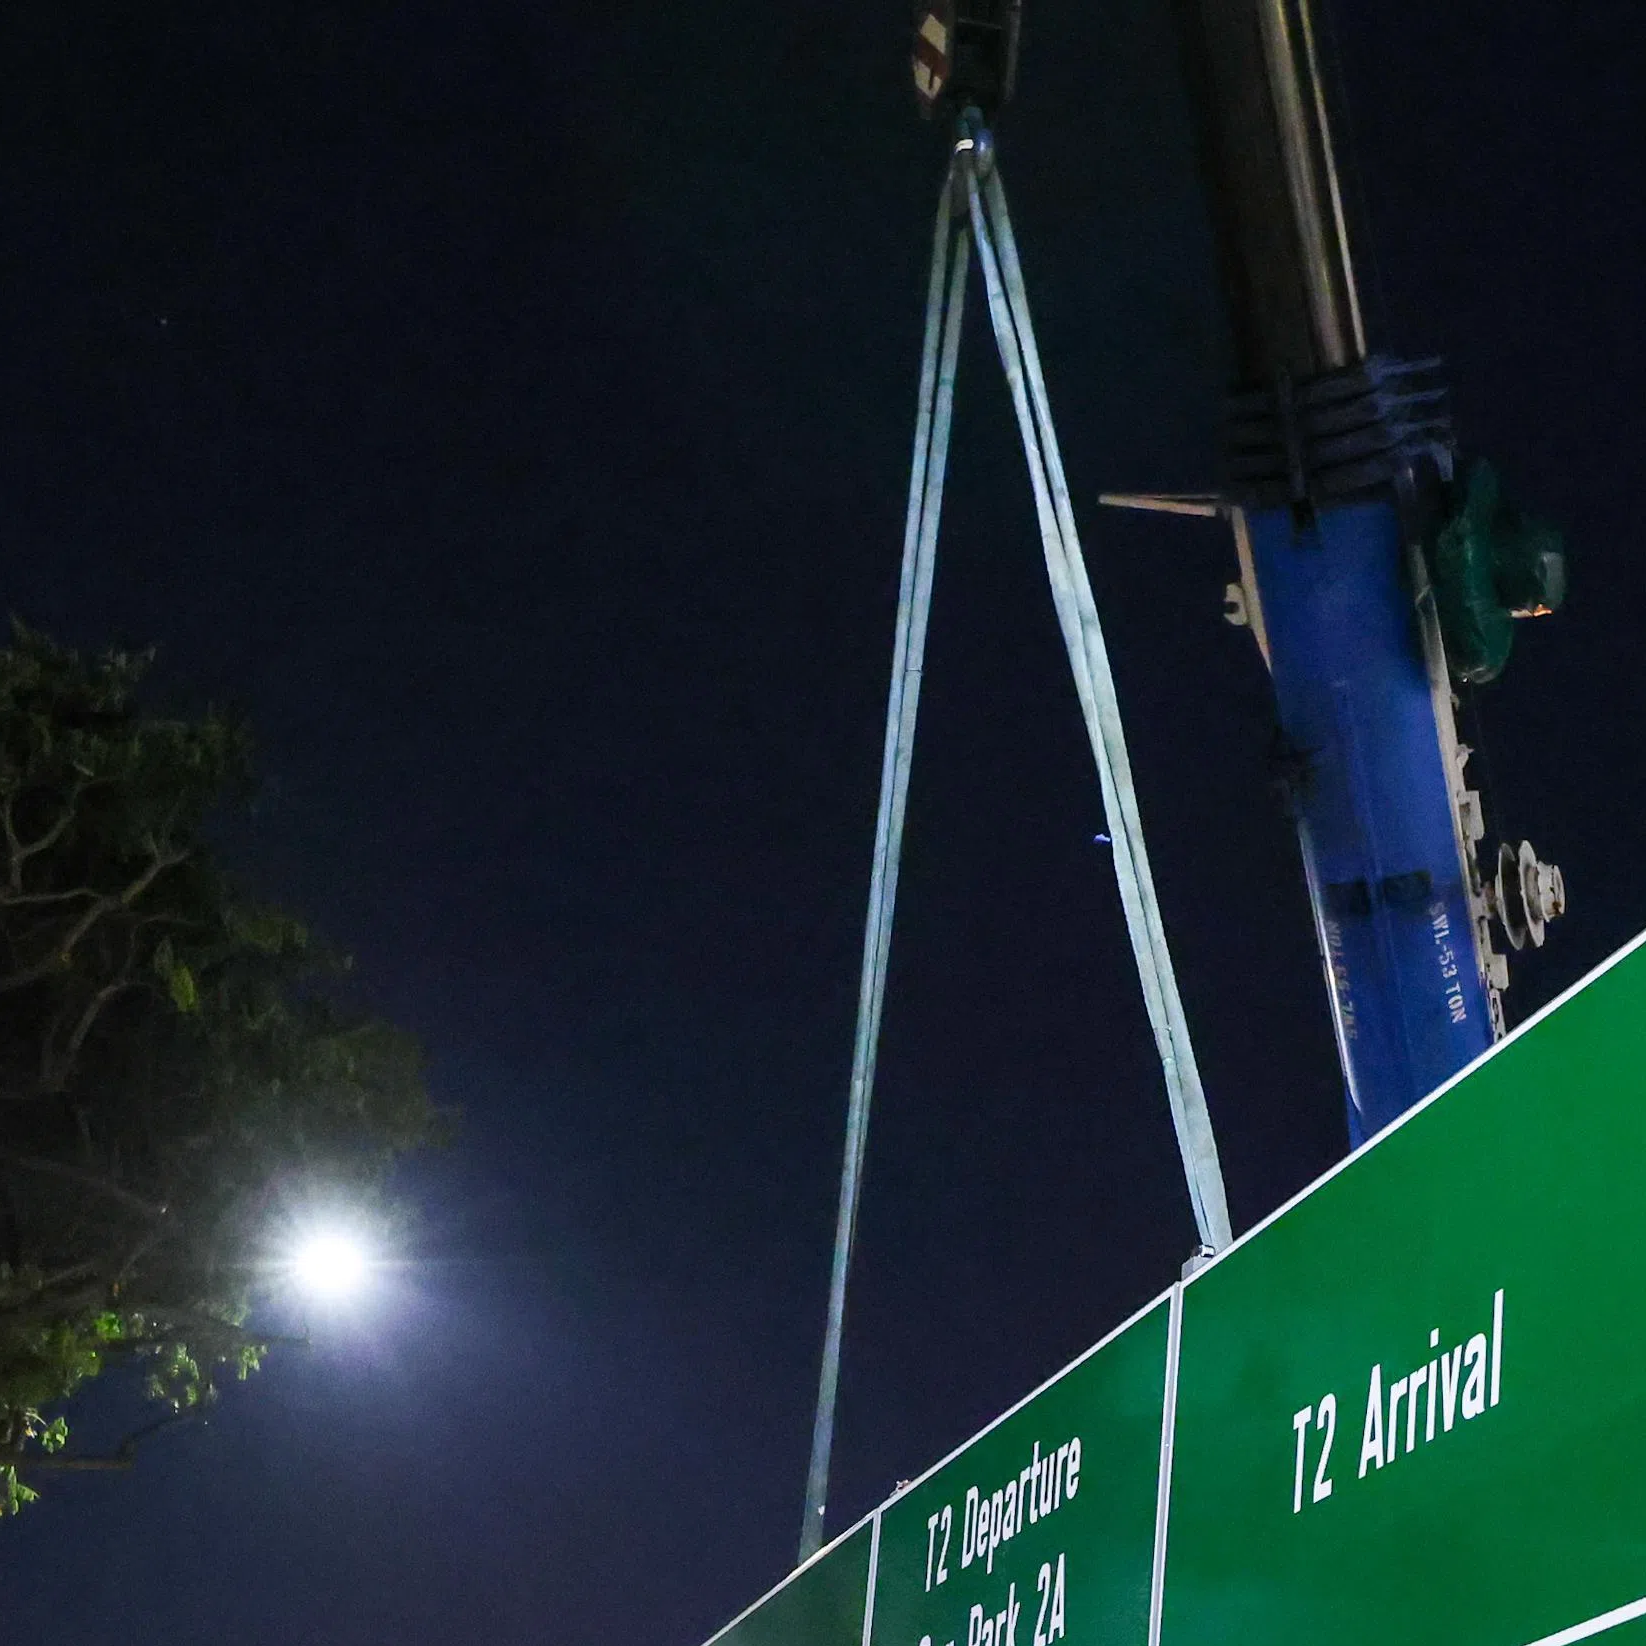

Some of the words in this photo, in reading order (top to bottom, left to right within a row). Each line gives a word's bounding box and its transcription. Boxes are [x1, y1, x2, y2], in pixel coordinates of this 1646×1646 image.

[1445, 982, 1467, 1024] TON
[1293, 1393, 1337, 1514] T2
[1358, 1288, 1505, 1480] Arrival
[925, 1503, 953, 1592] T2
[961, 1437, 1082, 1574] Departure
